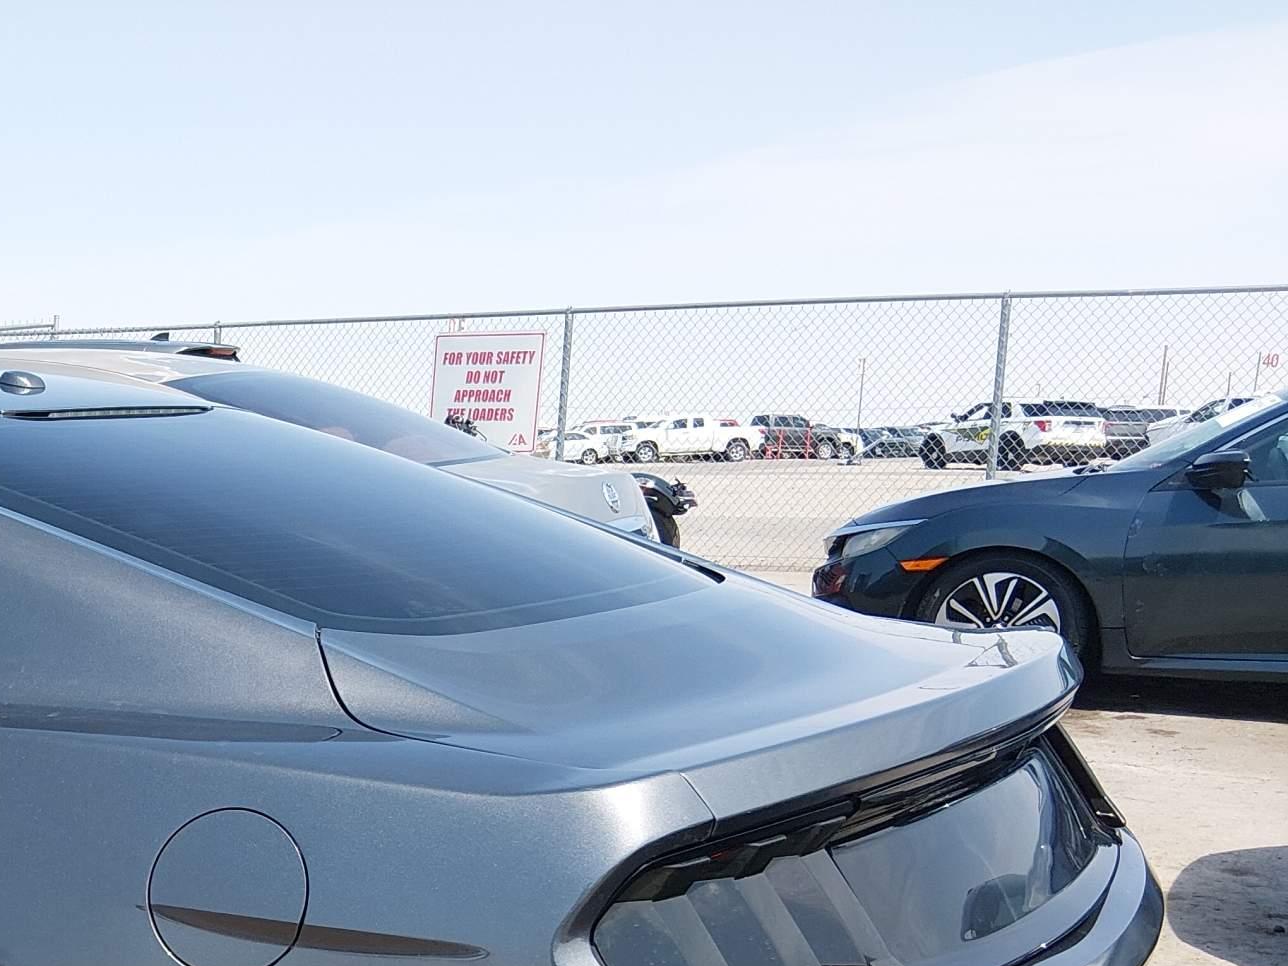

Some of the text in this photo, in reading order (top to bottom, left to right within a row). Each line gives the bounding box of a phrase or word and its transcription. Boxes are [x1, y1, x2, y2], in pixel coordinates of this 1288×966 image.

[443, 350, 536, 366] FOR YOUR SAFETY
[465, 370, 505, 384] DO NOT
[454, 389, 512, 403] APPROACH
[468, 408, 514, 422] LOADERS
